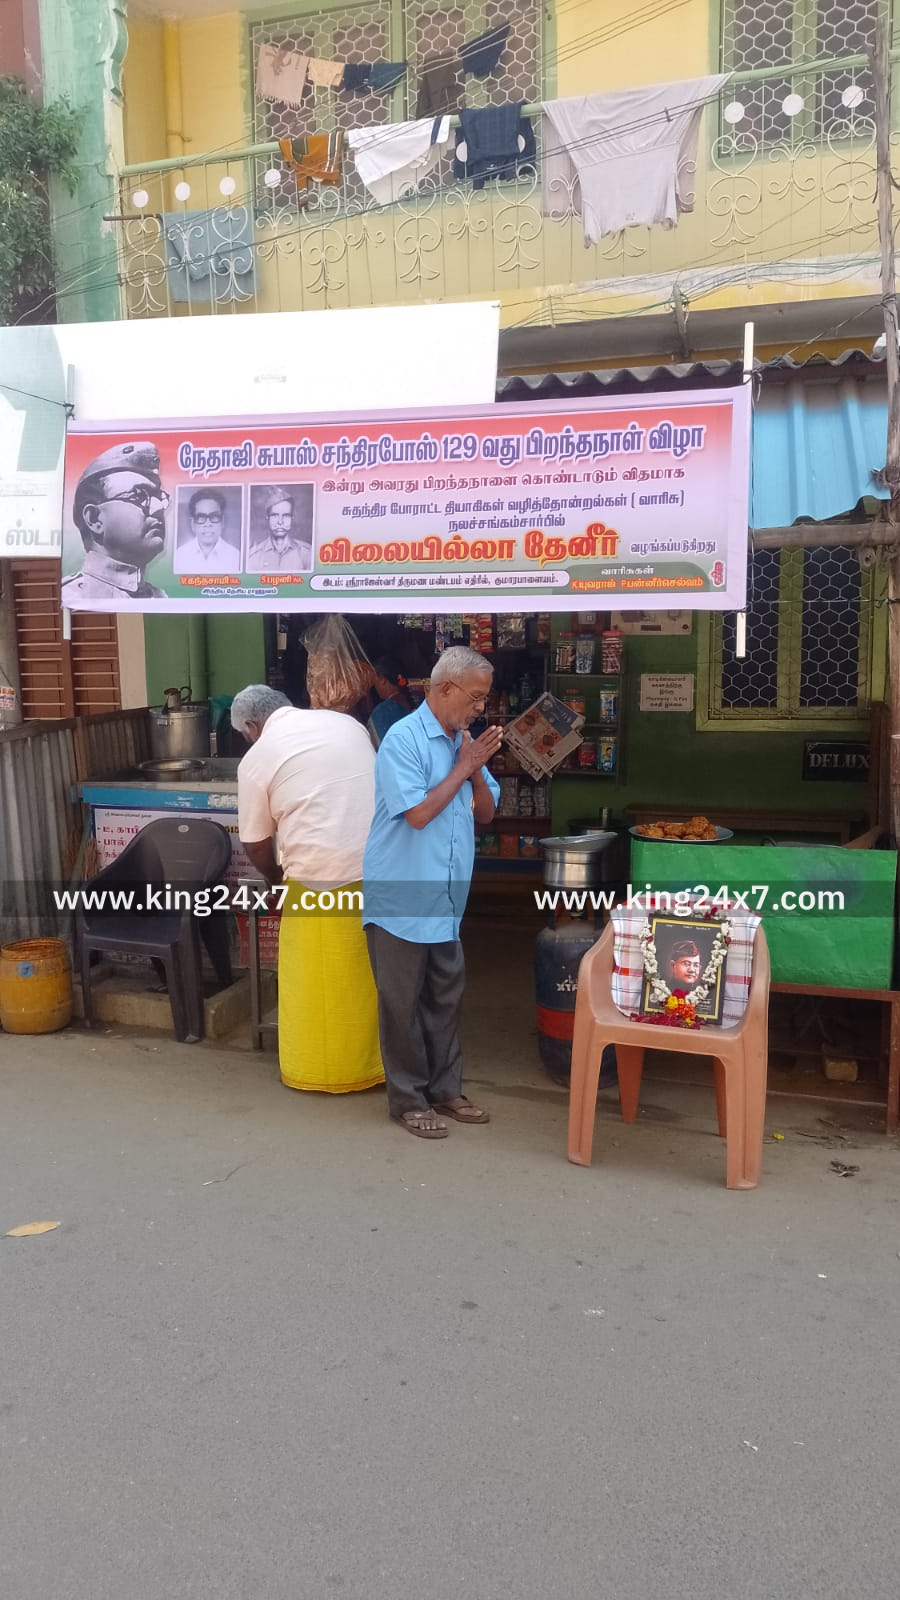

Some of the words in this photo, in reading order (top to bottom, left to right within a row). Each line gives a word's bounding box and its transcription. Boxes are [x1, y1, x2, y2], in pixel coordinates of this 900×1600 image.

[180, 441, 252, 474] நேதாஜி
[258, 440, 317, 466] சுபாஸ்
[322, 434, 437, 471] சந்திரபோஸ்
[443, 436, 477, 460] 129
[483, 436, 520, 466] வது
[527, 425, 644, 462] பிறந்தநாள்
[649, 423, 704, 457] விழா
[322, 478, 365, 494] இன்று
[369, 479, 419, 493] அவரது
[424, 473, 517, 492] பிறந்தநாளை
[522, 469, 618, 486] கொண்டாடும்
[622, 466, 685, 483] விதமாக
[342, 502, 387, 518] சுதந்திர
[390, 501, 442, 515] போராட்ட
[445, 498, 504, 516] தியாகிகள்
[508, 492, 627, 514] வழித்தோன்றல்கள்
[319, 536, 516, 564] விலையில்லா
[524, 522, 619, 566] தேனீர்
[630, 538, 716, 554] வழங்கப்படுகிறது
